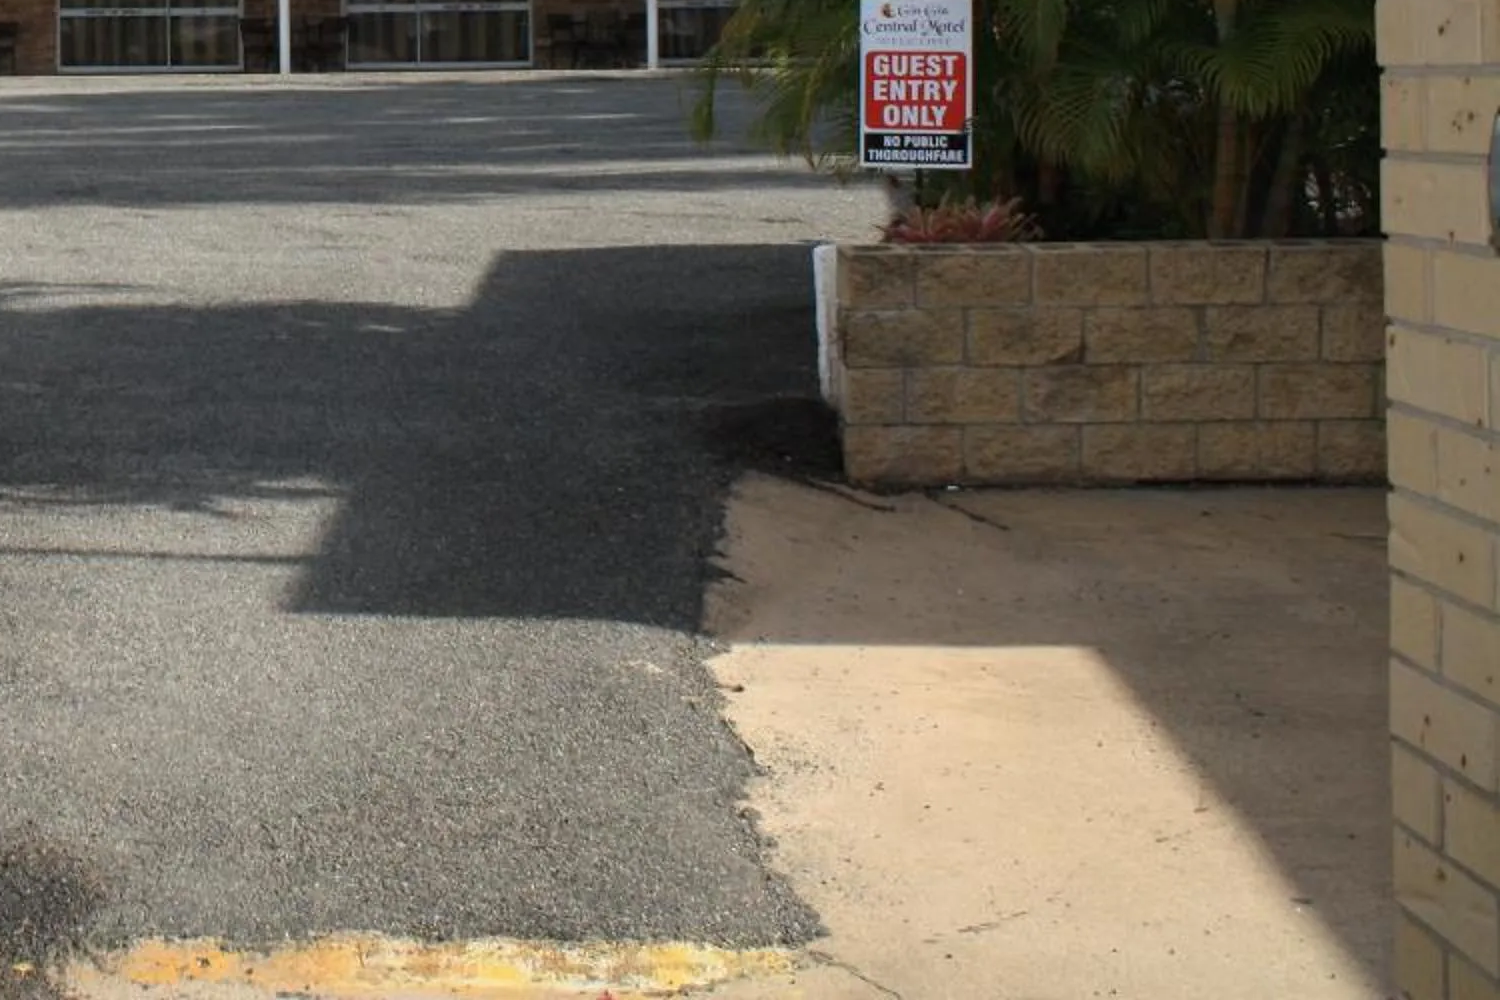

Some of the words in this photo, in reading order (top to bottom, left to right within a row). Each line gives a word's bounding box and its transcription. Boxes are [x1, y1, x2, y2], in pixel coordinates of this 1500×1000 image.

[863, 18, 917, 35] Central
[920, 17, 965, 36] Motel
[873, 55, 959, 77] GUEST
[873, 79, 958, 102] ENTRY
[883, 104, 948, 127] ONLY
[883, 135, 901, 147] NO
[904, 135, 948, 147] PUBLIC
[868, 150, 964, 162] THOROUGHFARE
